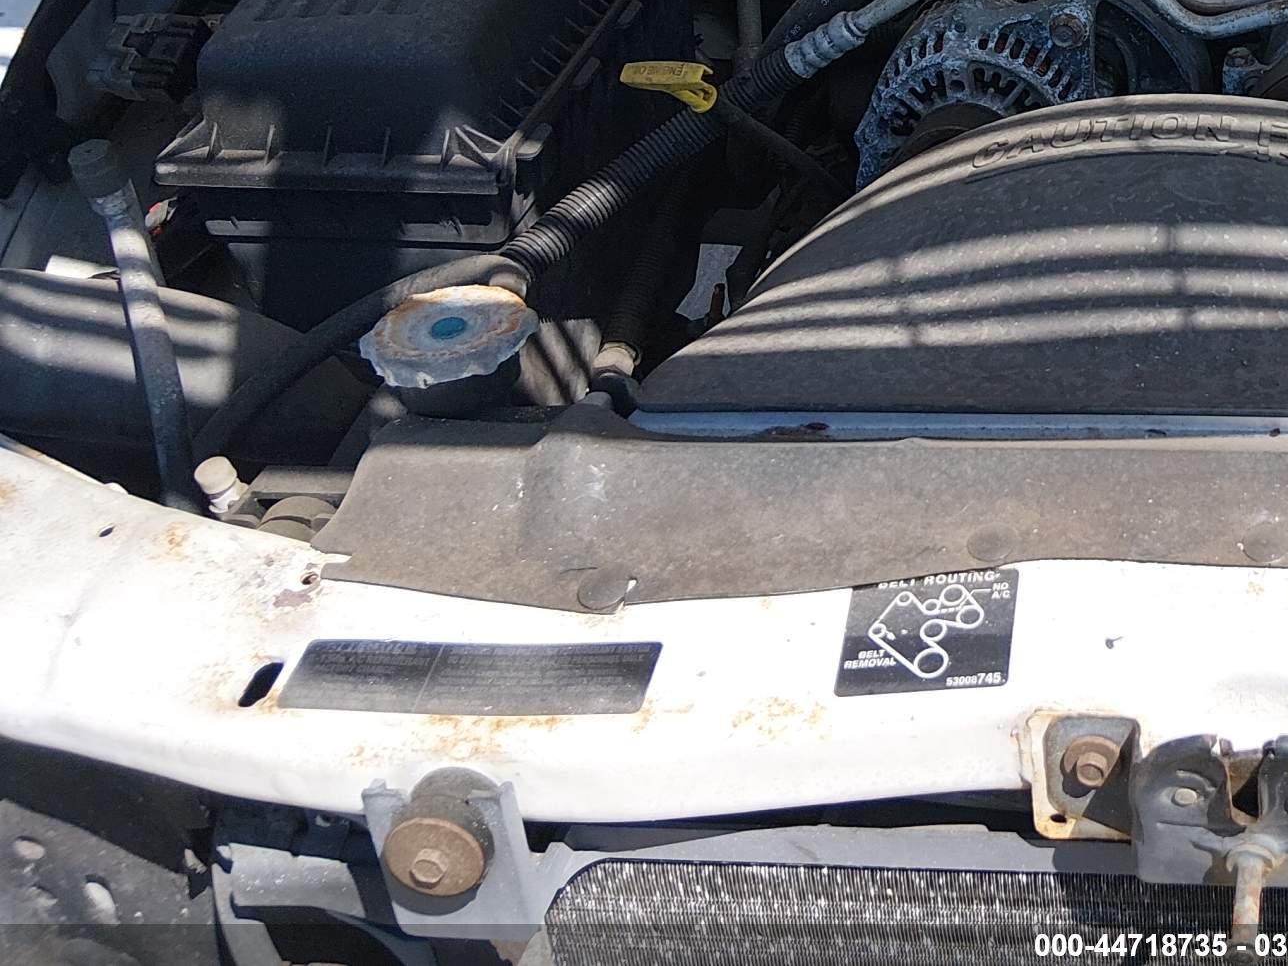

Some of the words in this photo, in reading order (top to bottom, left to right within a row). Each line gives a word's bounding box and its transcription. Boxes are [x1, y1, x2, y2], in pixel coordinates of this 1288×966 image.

[971, 113, 1238, 170] CAUTION
[924, 570, 996, 586] ROUTING
[858, 649, 887, 660] BELT
[843, 657, 897, 669] REMOVAL
